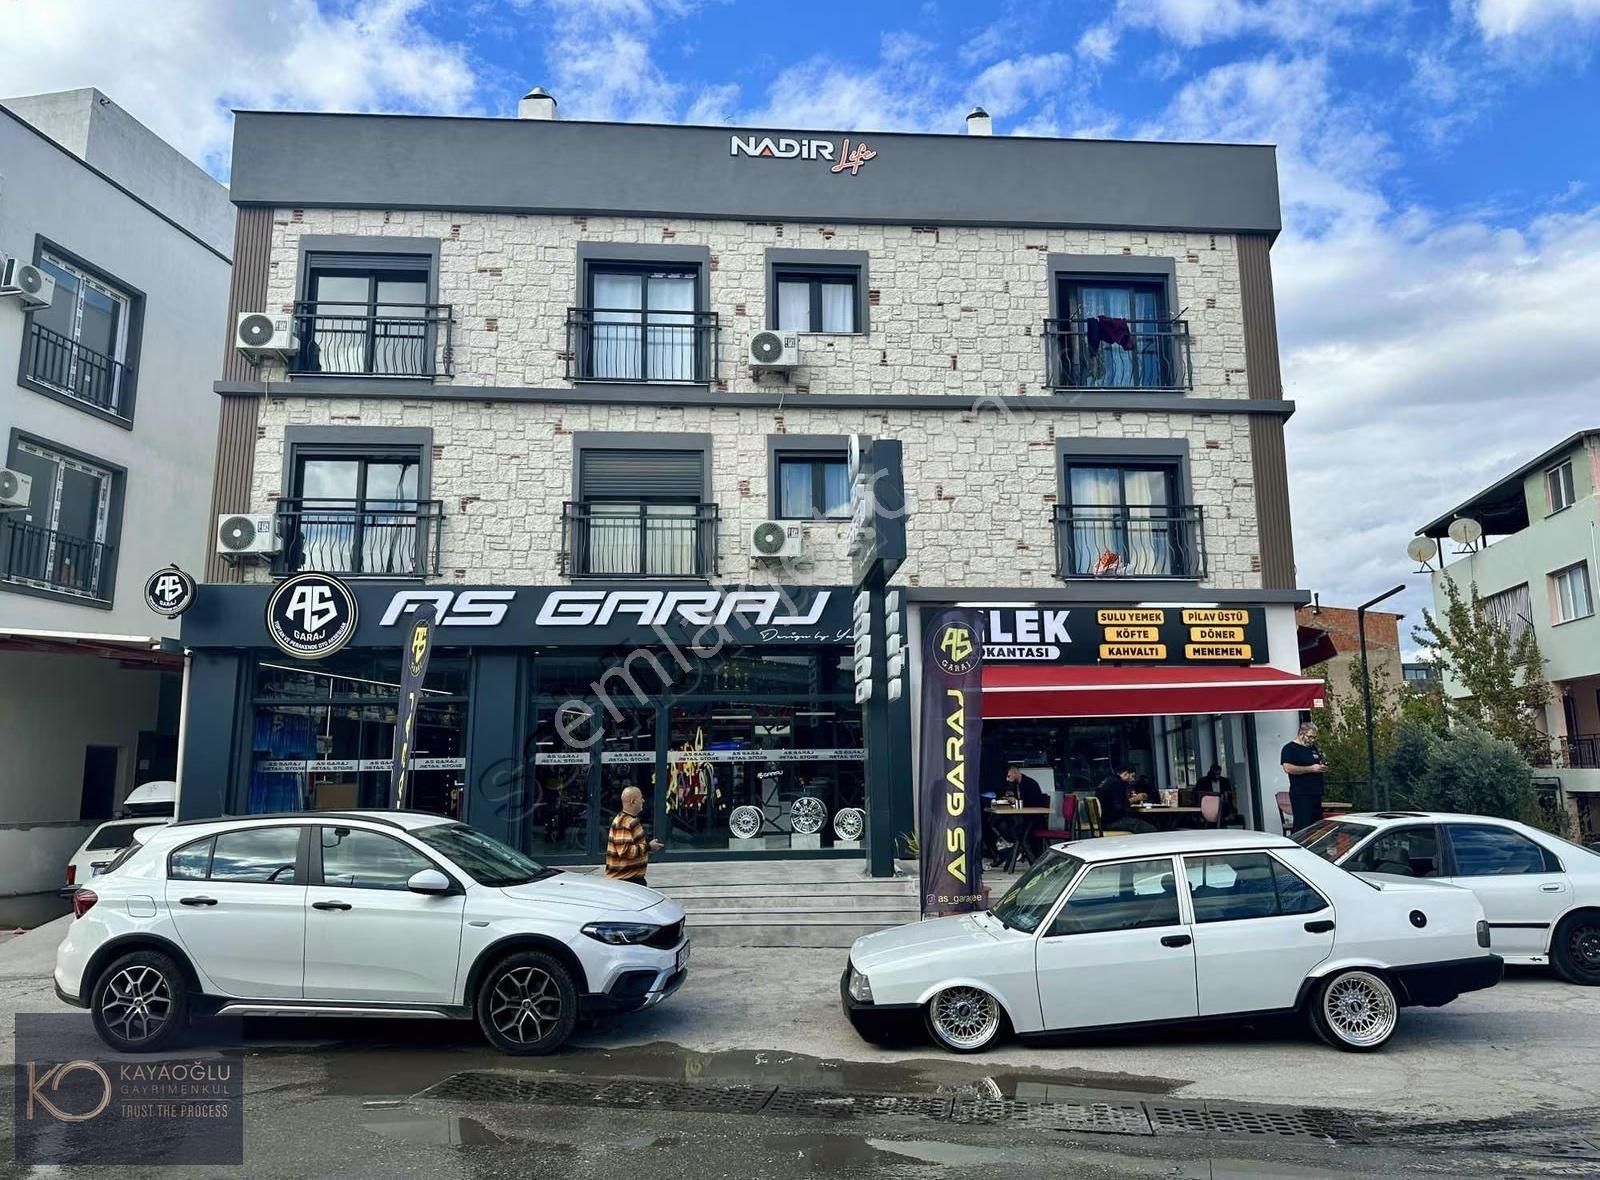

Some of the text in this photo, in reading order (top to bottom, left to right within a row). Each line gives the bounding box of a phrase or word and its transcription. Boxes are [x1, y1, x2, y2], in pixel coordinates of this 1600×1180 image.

[831, 138, 877, 175] Life
[155, 575, 183, 602] AS
[285, 585, 338, 633] AS
[379, 590, 832, 626] AS GARAJ
[1101, 613, 1161, 621] SULU YEMEK
[1188, 611, 1243, 621] PİLAV ÜSTÜ
[982, 610, 1072, 643] LEK
[1116, 628, 1149, 638] KÖFTE
[1200, 628, 1235, 638] DÖNER
[293, 629, 326, 642] GARAJ
[759, 628, 811, 642] Design
[814, 631, 829, 641] by
[940, 627, 973, 662] AS
[982, 647, 1048, 658] KANTASI
[1108, 647, 1158, 656] KAHVALTI
[1193, 647, 1242, 656] MENEMEN
[946, 689, 967, 884] AS GARAJ
